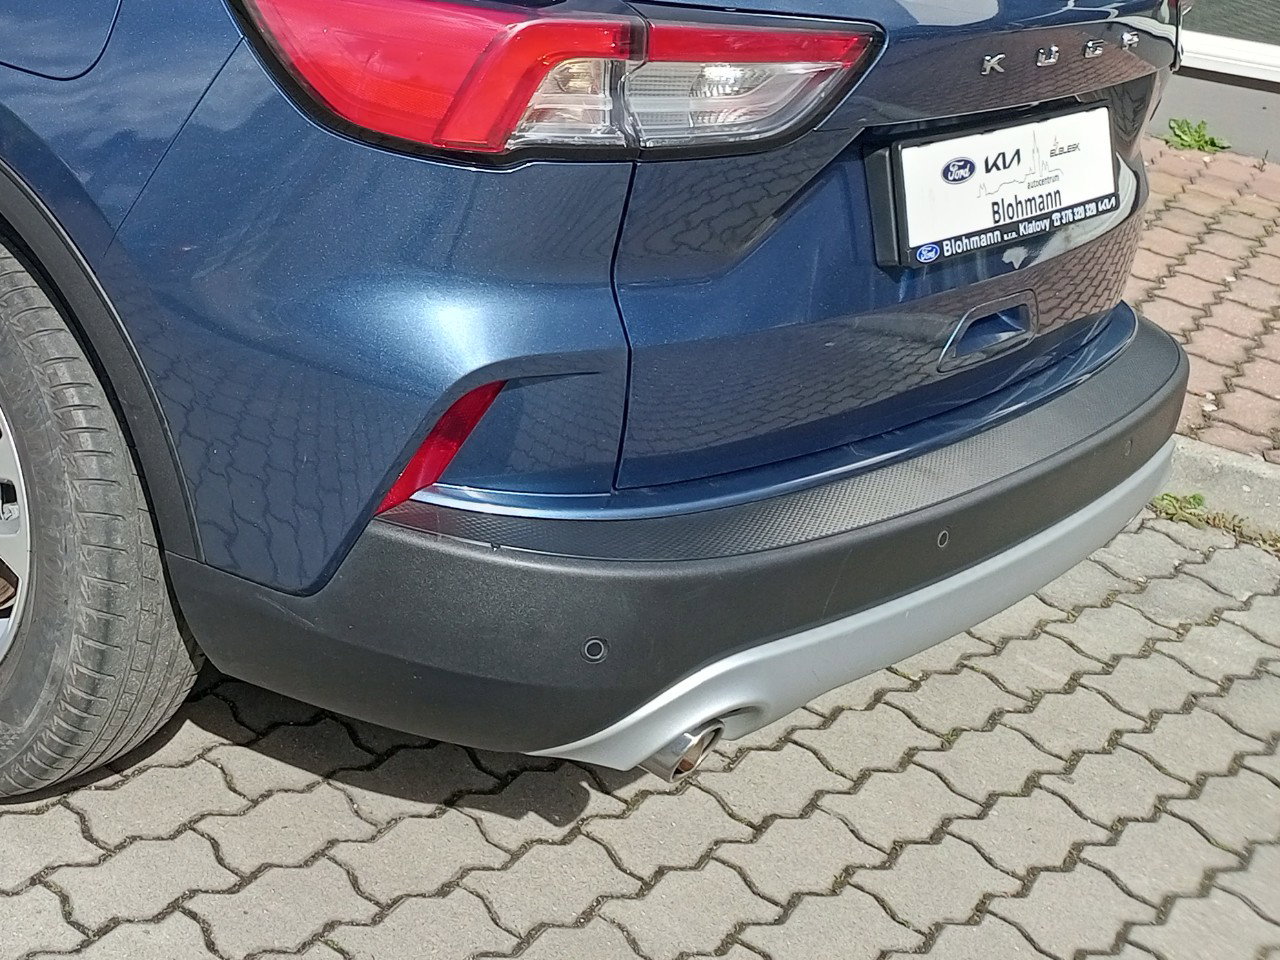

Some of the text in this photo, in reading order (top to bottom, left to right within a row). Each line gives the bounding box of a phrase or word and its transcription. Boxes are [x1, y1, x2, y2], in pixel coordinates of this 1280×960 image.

[984, 148, 1021, 173] KIA
[1027, 174, 1060, 189] autocentrum
[991, 189, 1062, 225] Blohmann
[943, 230, 1002, 257] Blohmann
[1019, 217, 1051, 237] Klatovy
